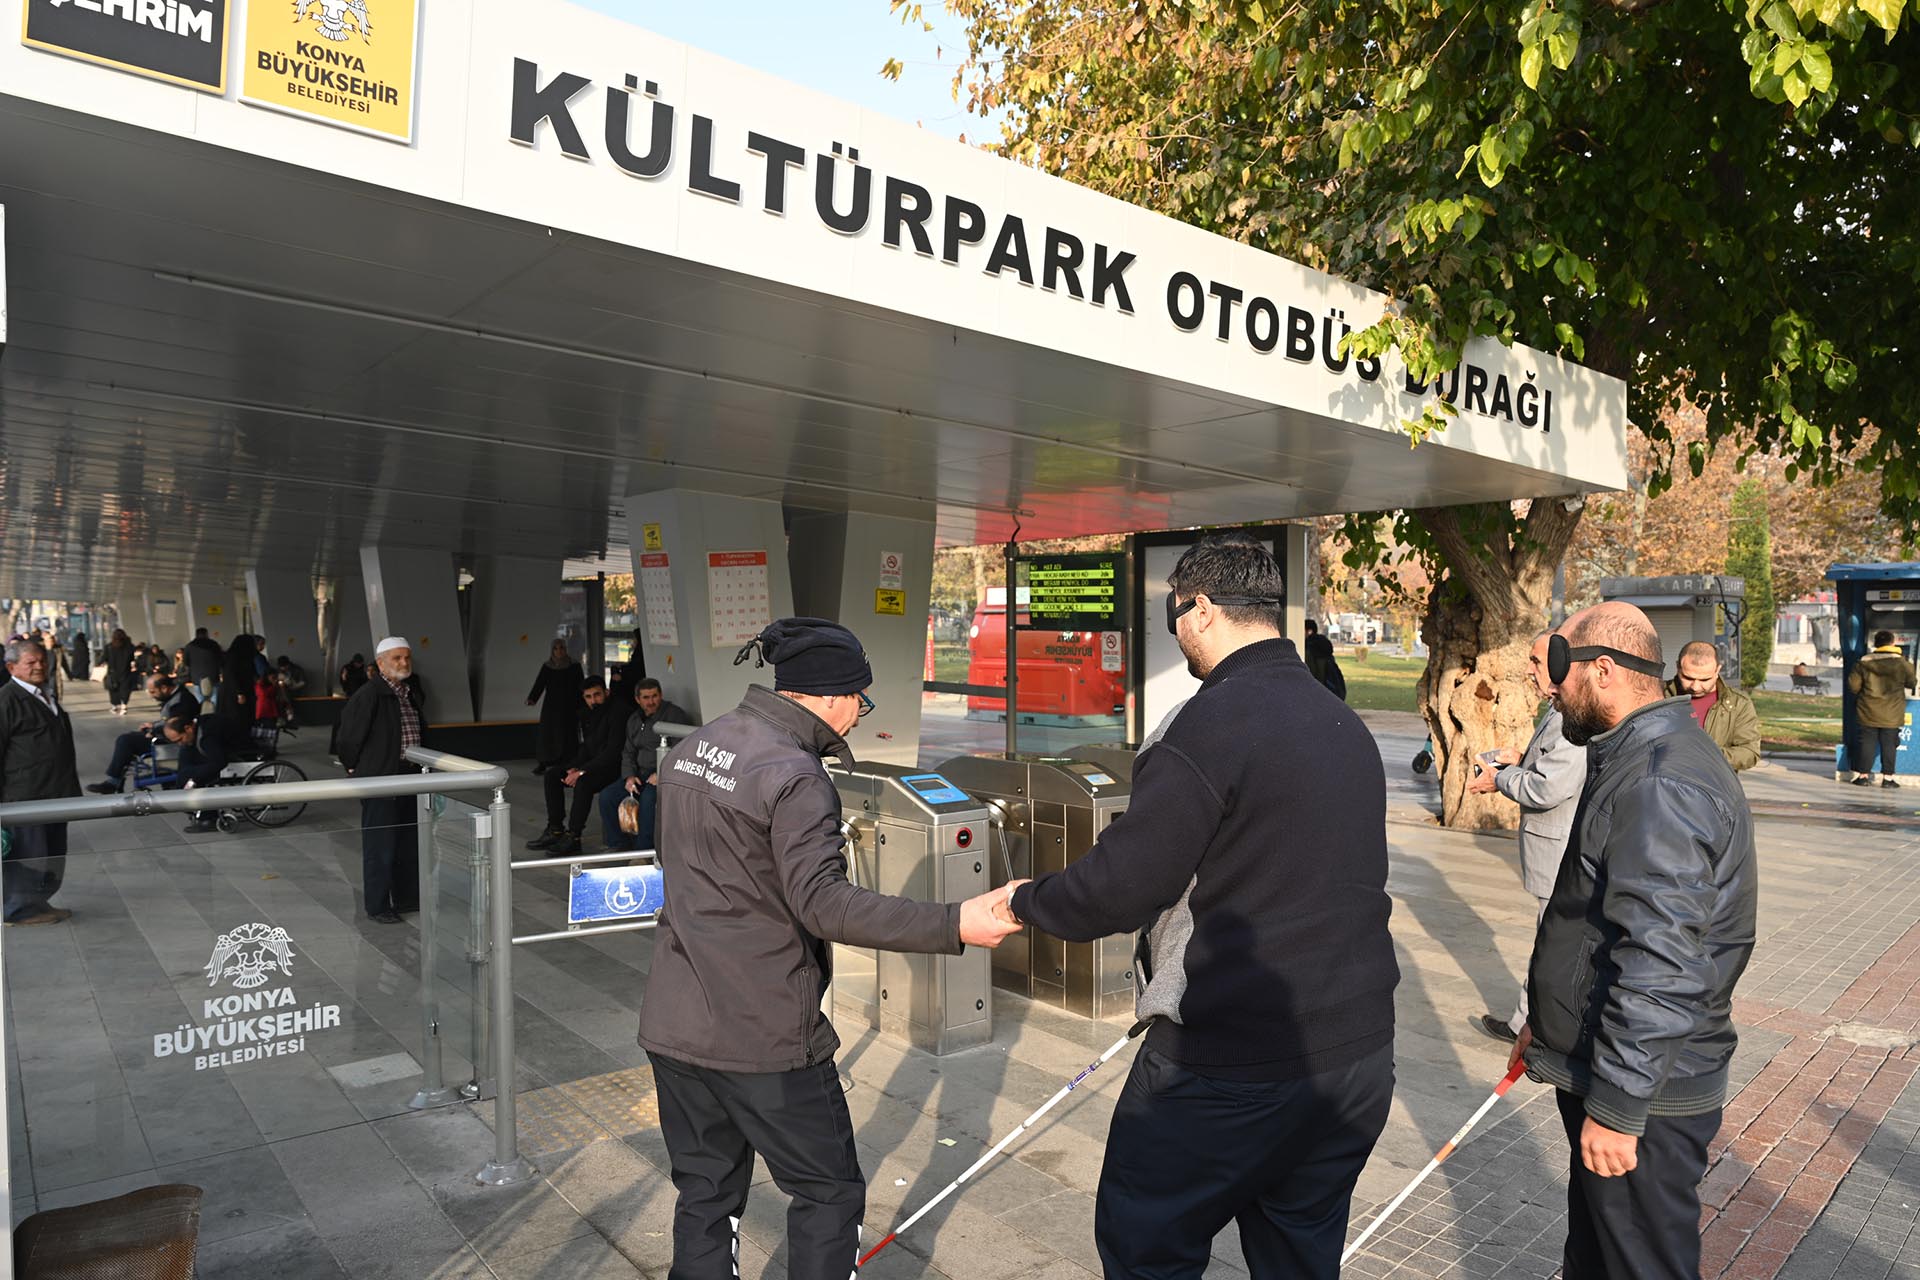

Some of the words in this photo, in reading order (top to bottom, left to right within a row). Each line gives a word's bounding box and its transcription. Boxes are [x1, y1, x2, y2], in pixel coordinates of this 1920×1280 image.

[296, 40, 366, 73] KONYA
[257, 50, 398, 106] BÜYÜKŞEHİR
[287, 82, 371, 114] BELEDİYESİ
[510, 56, 1137, 315] KÜLTÜRPARK
[673, 757, 707, 778] DAİRESİ
[203, 986, 297, 1019] KONYA
[153, 1002, 341, 1058] BÜYÜKŞEHİR
[194, 1035, 305, 1071] BELEDİYESİ
